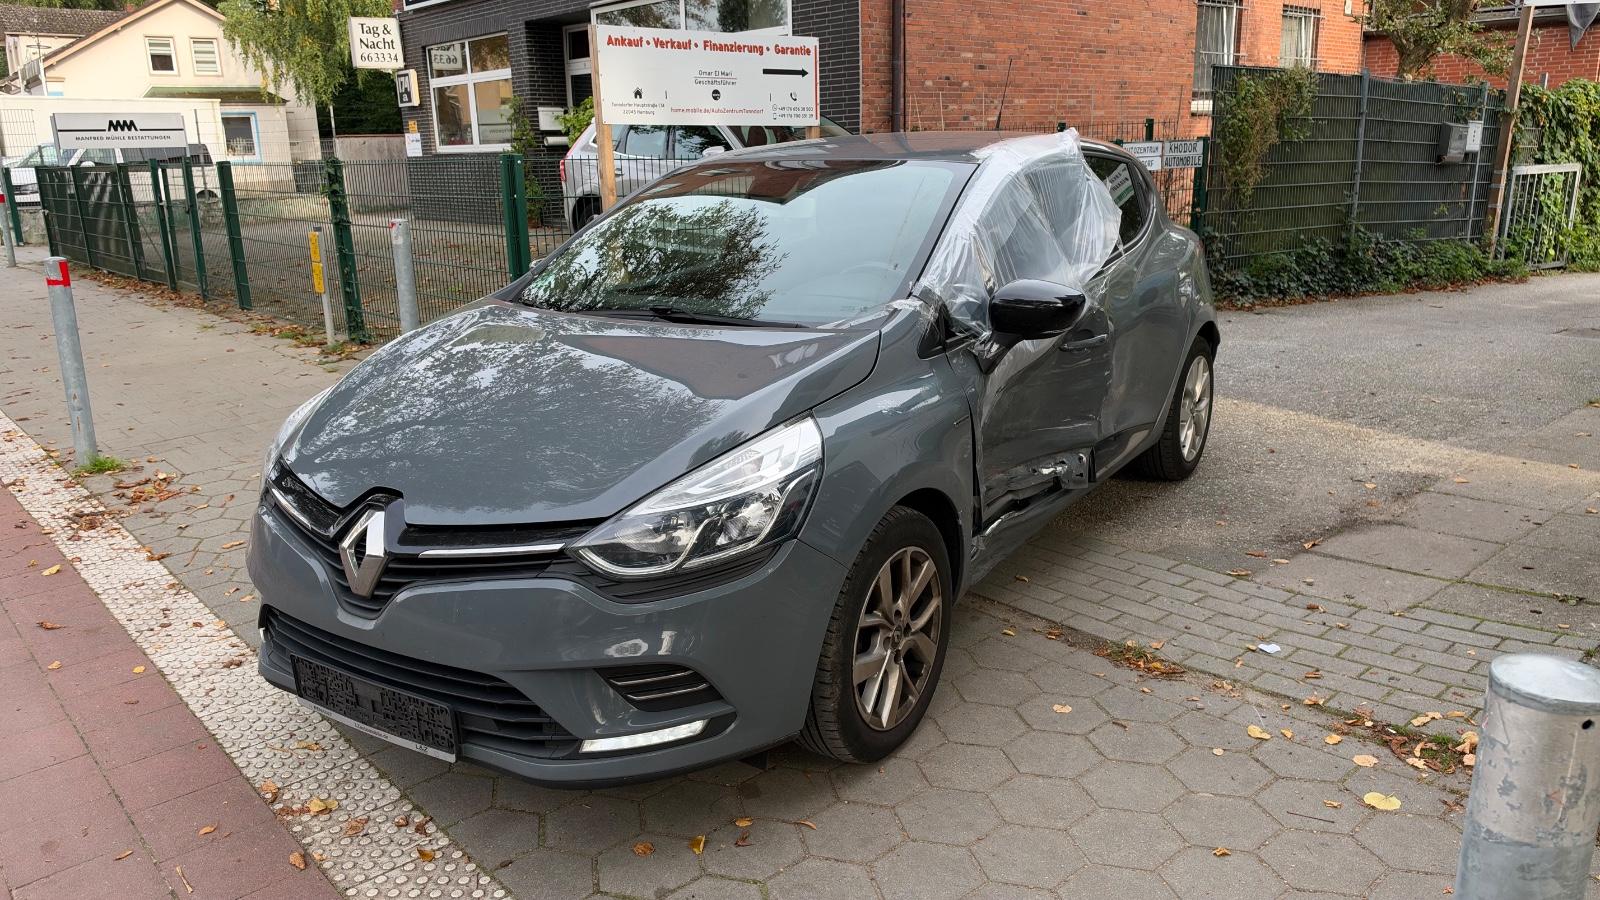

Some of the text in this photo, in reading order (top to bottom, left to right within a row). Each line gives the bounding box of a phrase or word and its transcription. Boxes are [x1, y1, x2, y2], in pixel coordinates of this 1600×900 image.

[358, 23, 392, 38] Tag &
[359, 37, 395, 50] Nacht
[607, 35, 812, 56] Ankauf Verkauf Finanzierung Garantie
[360, 52, 399, 63] 663334
[402, 93, 409, 102] a
[1168, 142, 1198, 153] KHODOR
[1164, 156, 1202, 167] AUTOMOBILE
